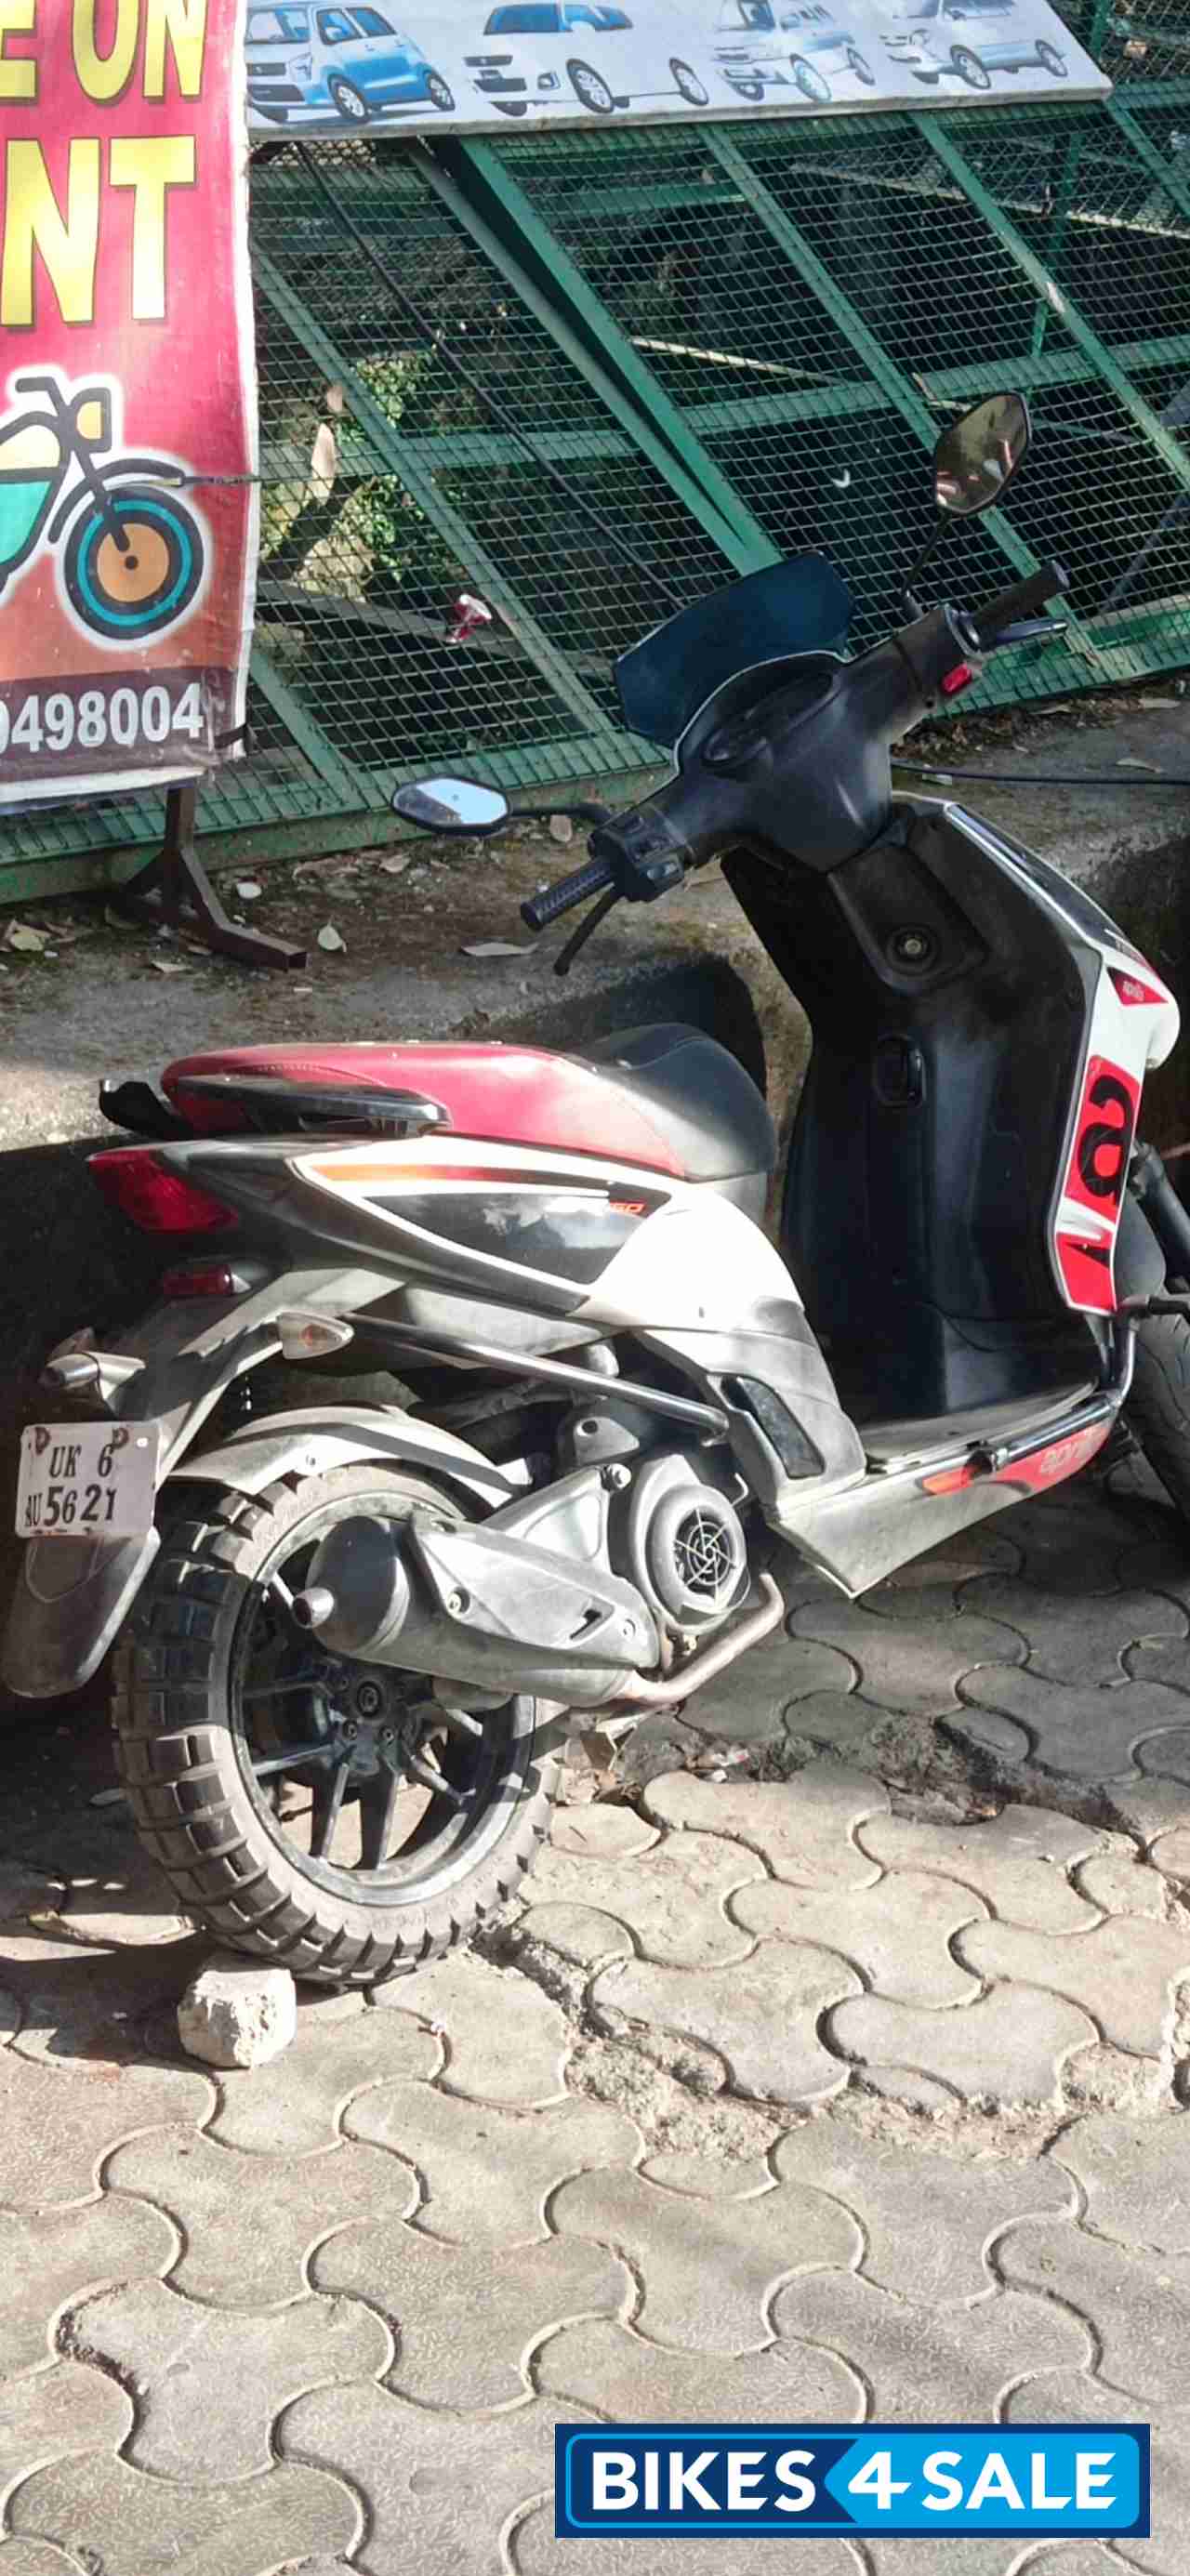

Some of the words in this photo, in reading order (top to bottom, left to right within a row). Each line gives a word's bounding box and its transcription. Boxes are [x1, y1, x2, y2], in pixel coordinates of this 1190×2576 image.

[72, 0, 207, 99] ON
[0, 135, 195, 325] NT
[49, 1445, 82, 1478] UK
[98, 1444, 113, 1477] 6
